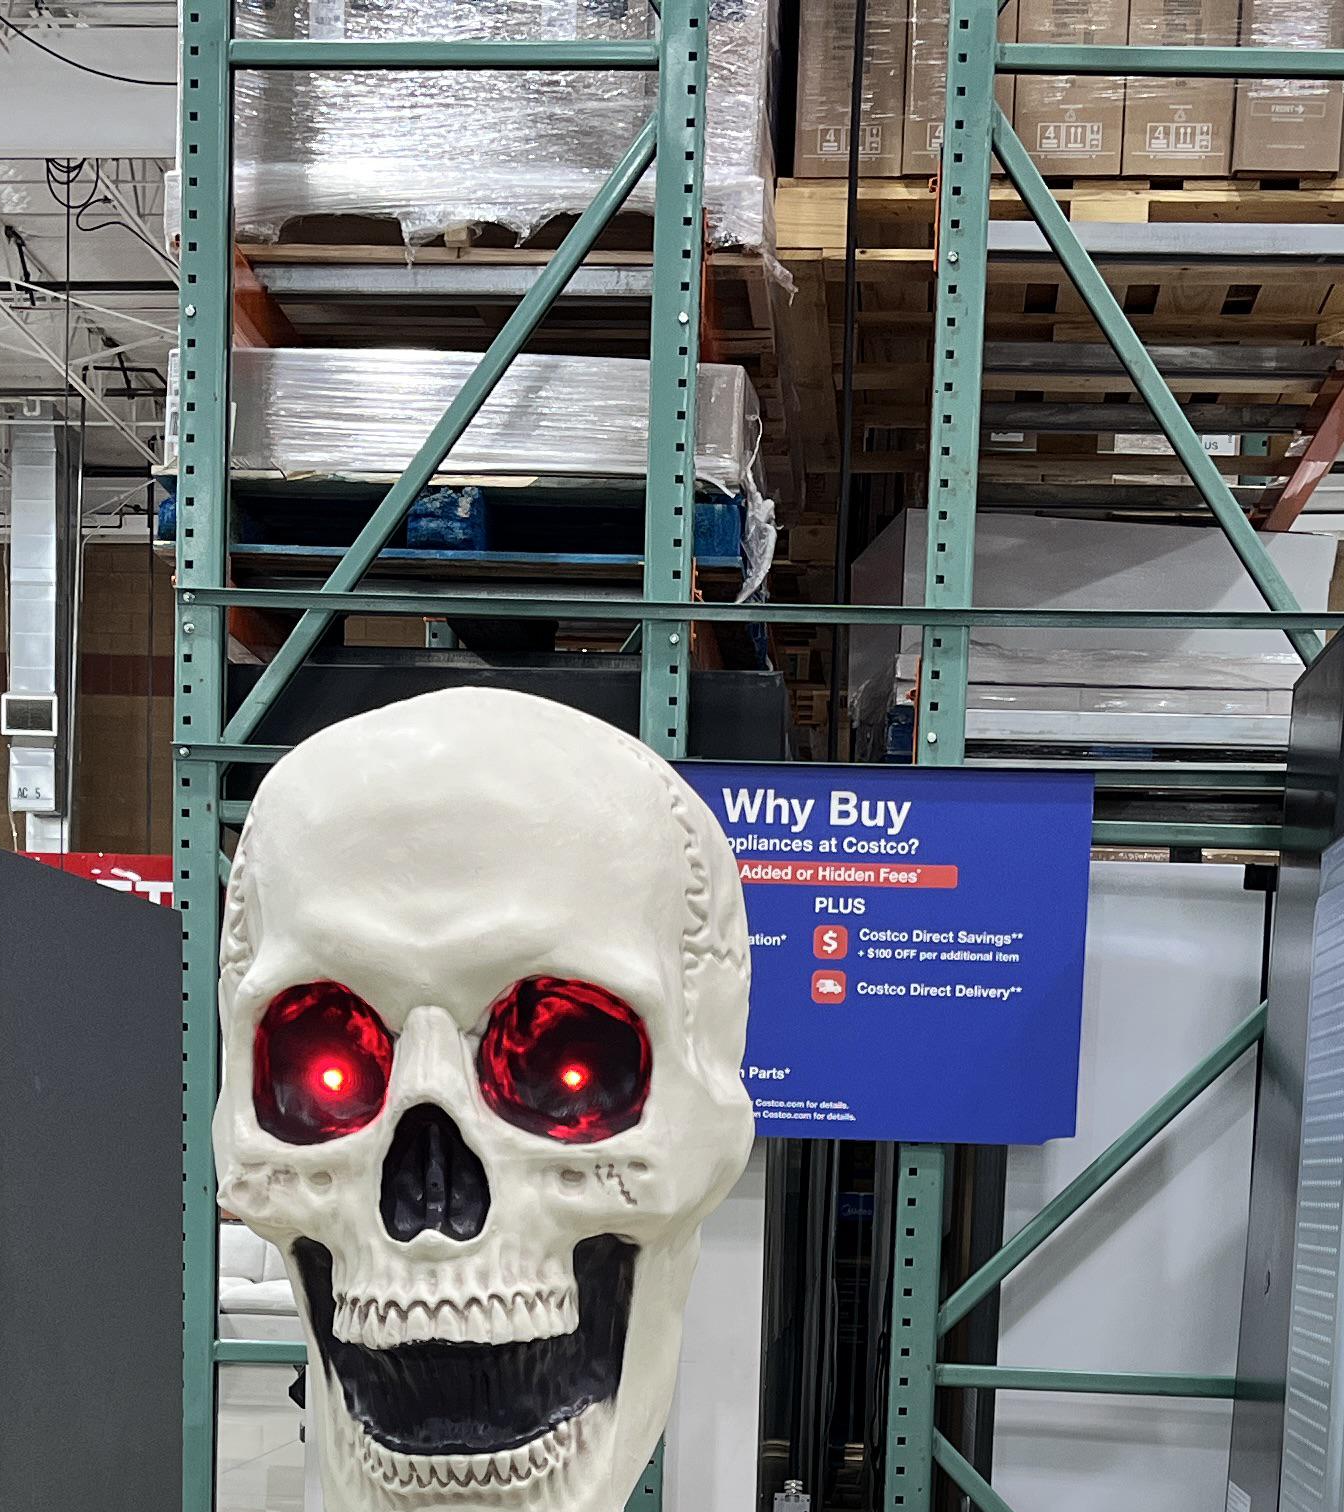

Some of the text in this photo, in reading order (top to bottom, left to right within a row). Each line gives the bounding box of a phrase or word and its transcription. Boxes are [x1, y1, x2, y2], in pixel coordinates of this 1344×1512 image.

[1203, 440, 1219, 450] US
[17, 787, 41, 799] AC 5
[722, 788, 912, 834] Why Buy
[819, 838, 837, 852] at
[843, 837, 919, 855] Costco?
[740, 864, 792, 880] Added
[796, 868, 814, 881] or
[818, 867, 875, 882] Hidden
[815, 897, 866, 914] PLUS
[859, 928, 908, 942] Costco
[913, 930, 954, 943] Direct
[867, 948, 891, 959] $100
[895, 949, 917, 959] OFF
[920, 951, 937, 961] per
[940, 950, 992, 961] additional
[996, 952, 1019, 962] item
[857, 982, 906, 995] Costco
[910, 984, 951, 996] Direct
[755, 1098, 805, 1108] Costco.com
[806, 1100, 818, 1108] for
[813, 1112, 825, 1120] for
